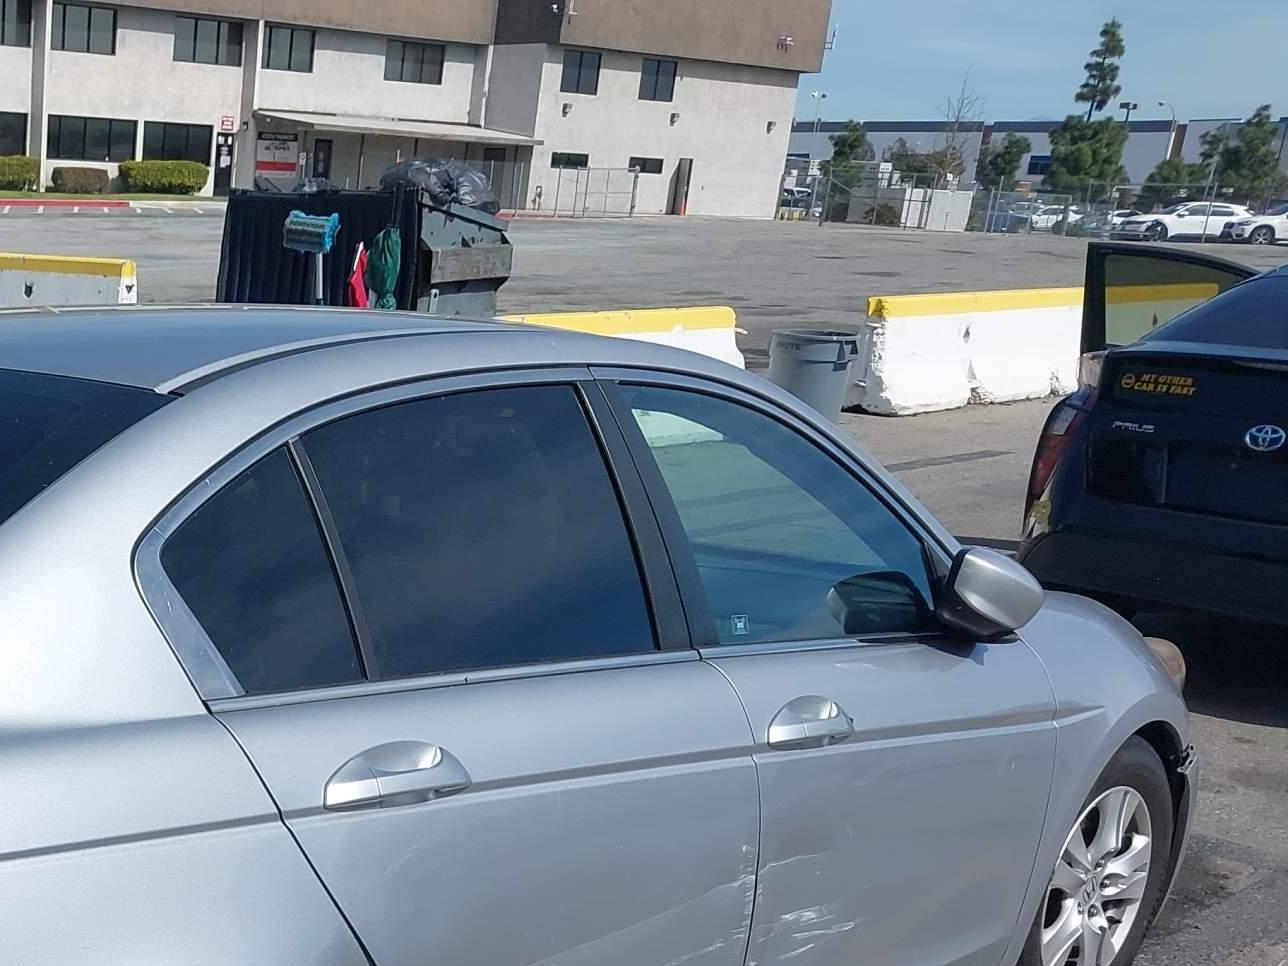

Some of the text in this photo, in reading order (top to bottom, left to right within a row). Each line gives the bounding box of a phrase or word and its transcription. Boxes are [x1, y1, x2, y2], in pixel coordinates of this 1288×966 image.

[1141, 373, 1157, 382] MY
[1159, 375, 1192, 385] OTHER
[1134, 382, 1196, 395] CAR IS FAST
[1112, 420, 1155, 433] PRIUS
